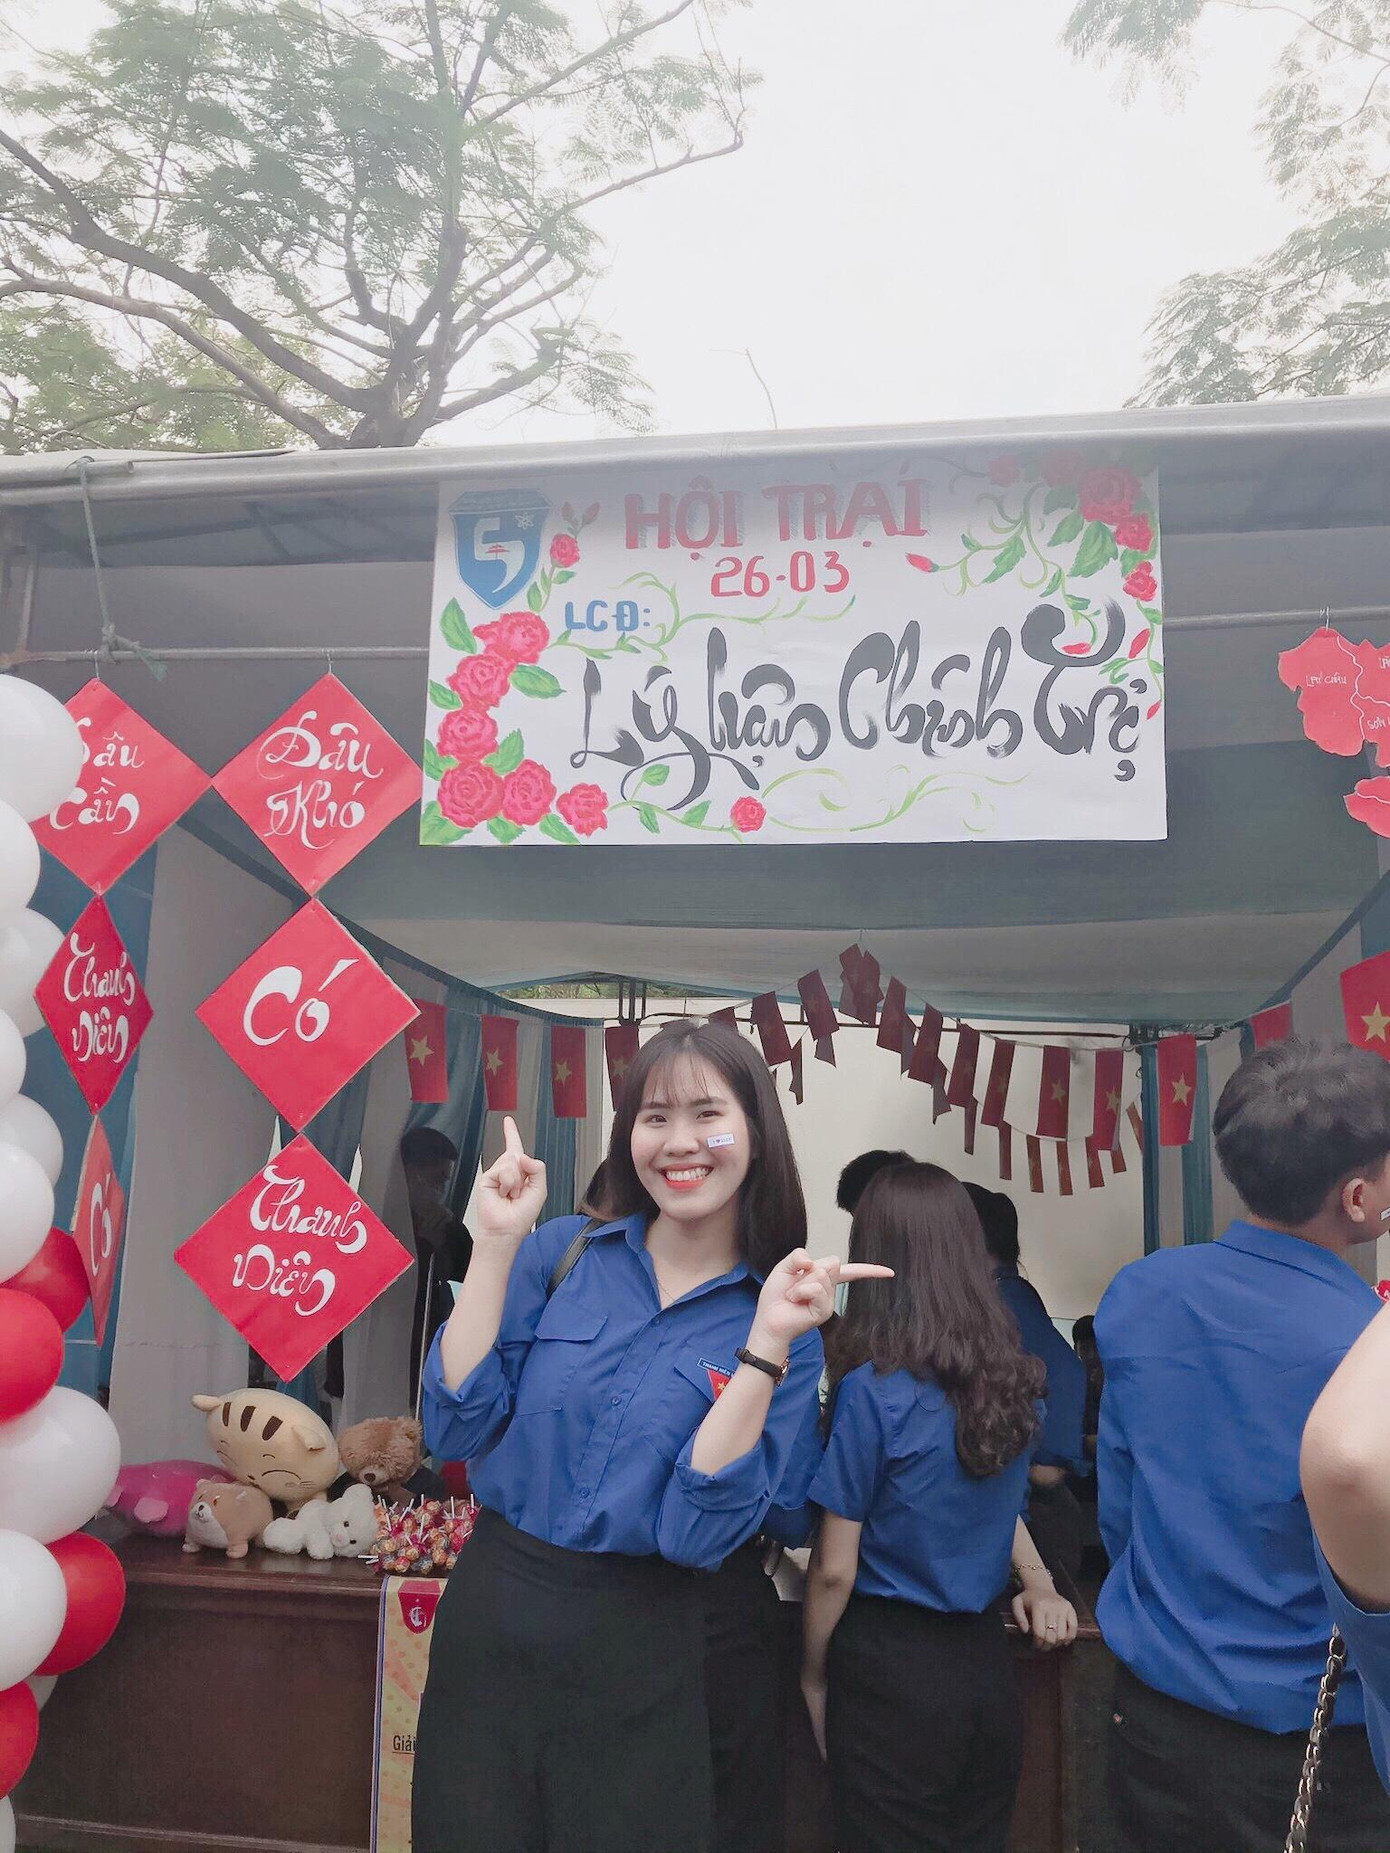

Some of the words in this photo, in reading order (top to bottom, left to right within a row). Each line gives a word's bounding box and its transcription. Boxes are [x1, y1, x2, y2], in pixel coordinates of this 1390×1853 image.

[624, 475, 744, 561] HỘI
[761, 479, 930, 548] TRẠI
[711, 551, 850, 598] 26-03
[565, 599, 651, 632] LCĐ:
[839, 620, 1023, 759] Chính
[76, 716, 145, 769] âu
[264, 779, 366, 850] Khó
[242, 958, 360, 1047] Có
[90, 1174, 112, 1277] Có
[249, 1165, 368, 1254] Thanh
[393, 1735, 416, 1751] Giải
